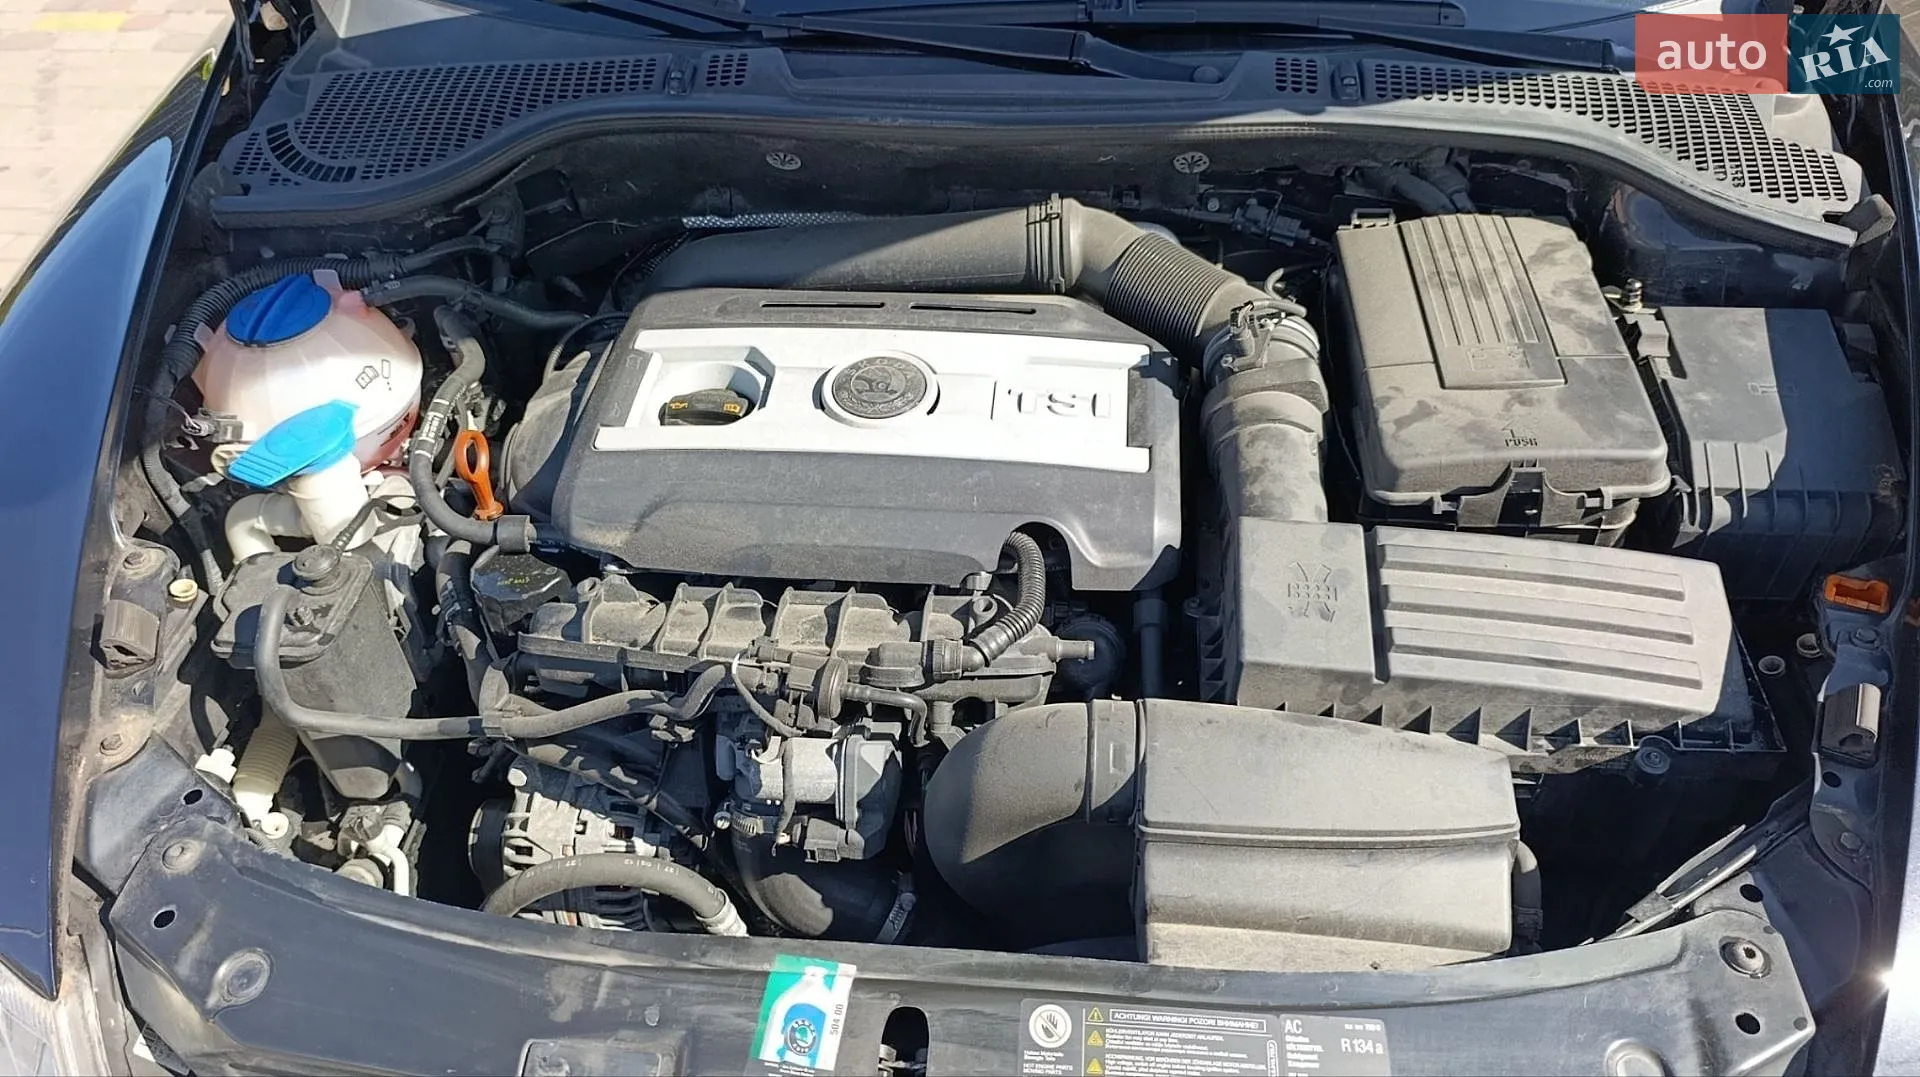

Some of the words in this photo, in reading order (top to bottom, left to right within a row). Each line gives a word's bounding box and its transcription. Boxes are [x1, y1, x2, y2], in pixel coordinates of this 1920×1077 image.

[1007, 386, 1111, 419] TSI
[1504, 438, 1538, 447] PUSH
[1284, 1019, 1302, 1034] AC
